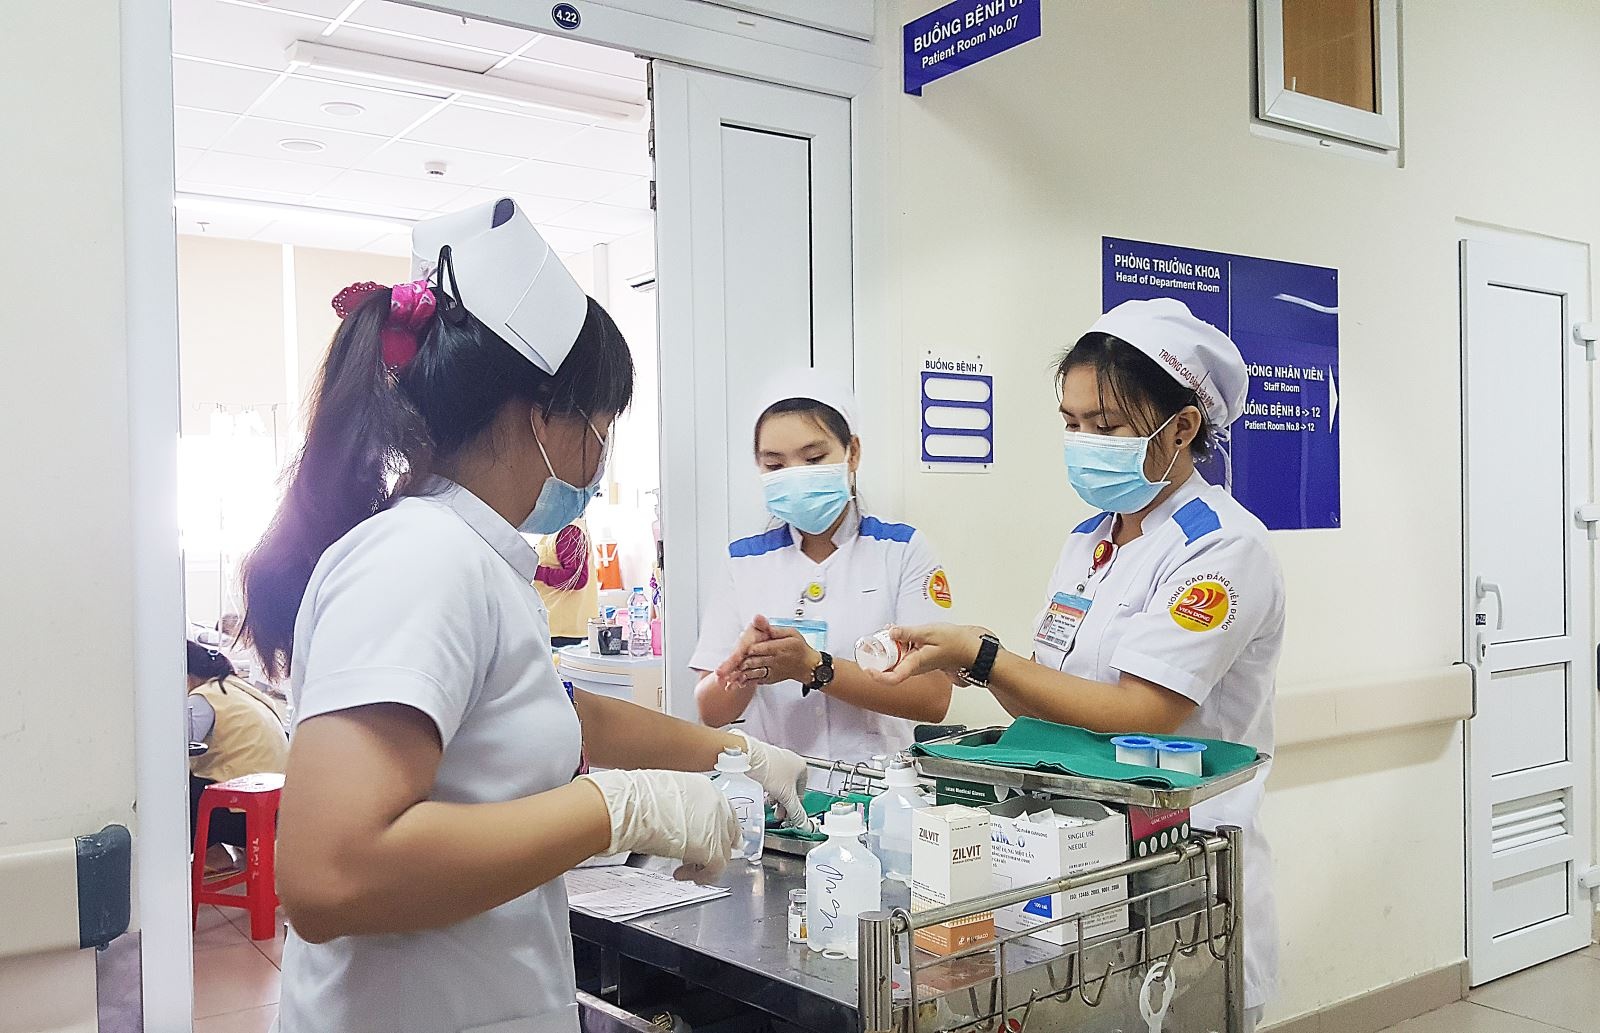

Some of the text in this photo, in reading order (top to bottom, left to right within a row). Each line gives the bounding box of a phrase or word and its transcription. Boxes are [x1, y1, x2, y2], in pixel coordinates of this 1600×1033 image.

[556, 10, 577, 23] 4.22
[914, 18, 961, 52] BUỒNG
[965, 0, 1005, 29] BỆNH
[922, 15, 1018, 68] Patient Room No.07
[1114, 252, 1150, 271] PHÒNG
[1195, 265, 1220, 279] KHOA
[1115, 271, 1220, 293] Head of Department Room
[979, 364, 983, 372] 7
[1245, 362, 1323, 381] HÒNG NHÂN VIÊN
[1264, 382, 1300, 393] Staff Room
[1270, 402, 1294, 419] BỆNH
[1295, 406, 1301, 417] 8
[1312, 407, 1321, 418] 12
[1244, 420, 1266, 430] Patient
[1267, 421, 1285, 431] Room
[1308, 423, 1315, 432] 12
[1185, 574, 1204, 587] CAO
[919, 827, 940, 843] ZILVIT
[1067, 830, 1095, 840] SINGLE USE
[952, 844, 982, 861] ZILVIT
[1067, 842, 1088, 851] NEEDLE
